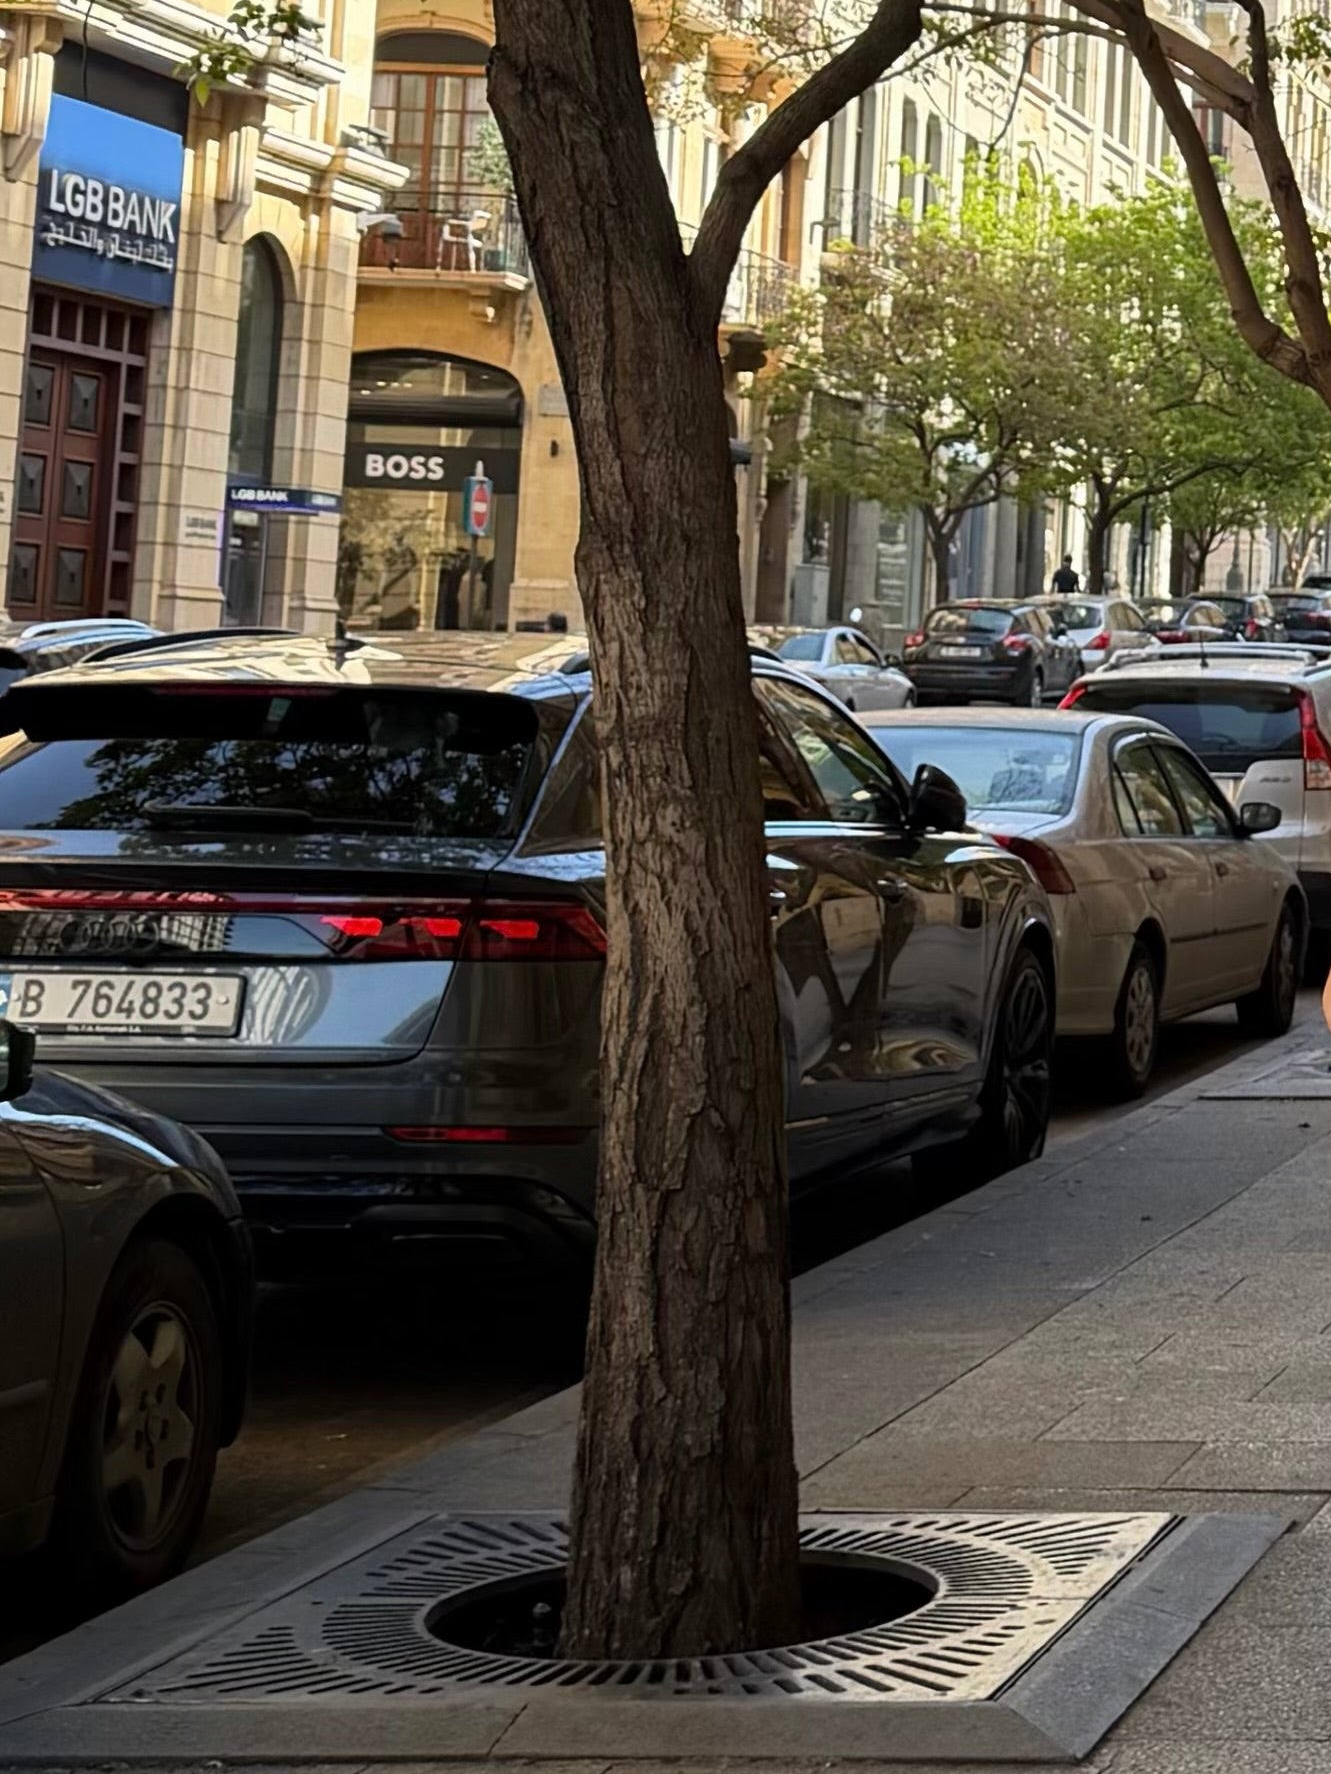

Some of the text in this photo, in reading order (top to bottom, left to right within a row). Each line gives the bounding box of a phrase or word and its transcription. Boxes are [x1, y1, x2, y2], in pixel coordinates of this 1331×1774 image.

[49, 168, 177, 244] LGB BANK
[365, 453, 445, 481] BOSS
[231, 488, 288, 503] LGB BANK
[19, 978, 213, 1022] B 764833
